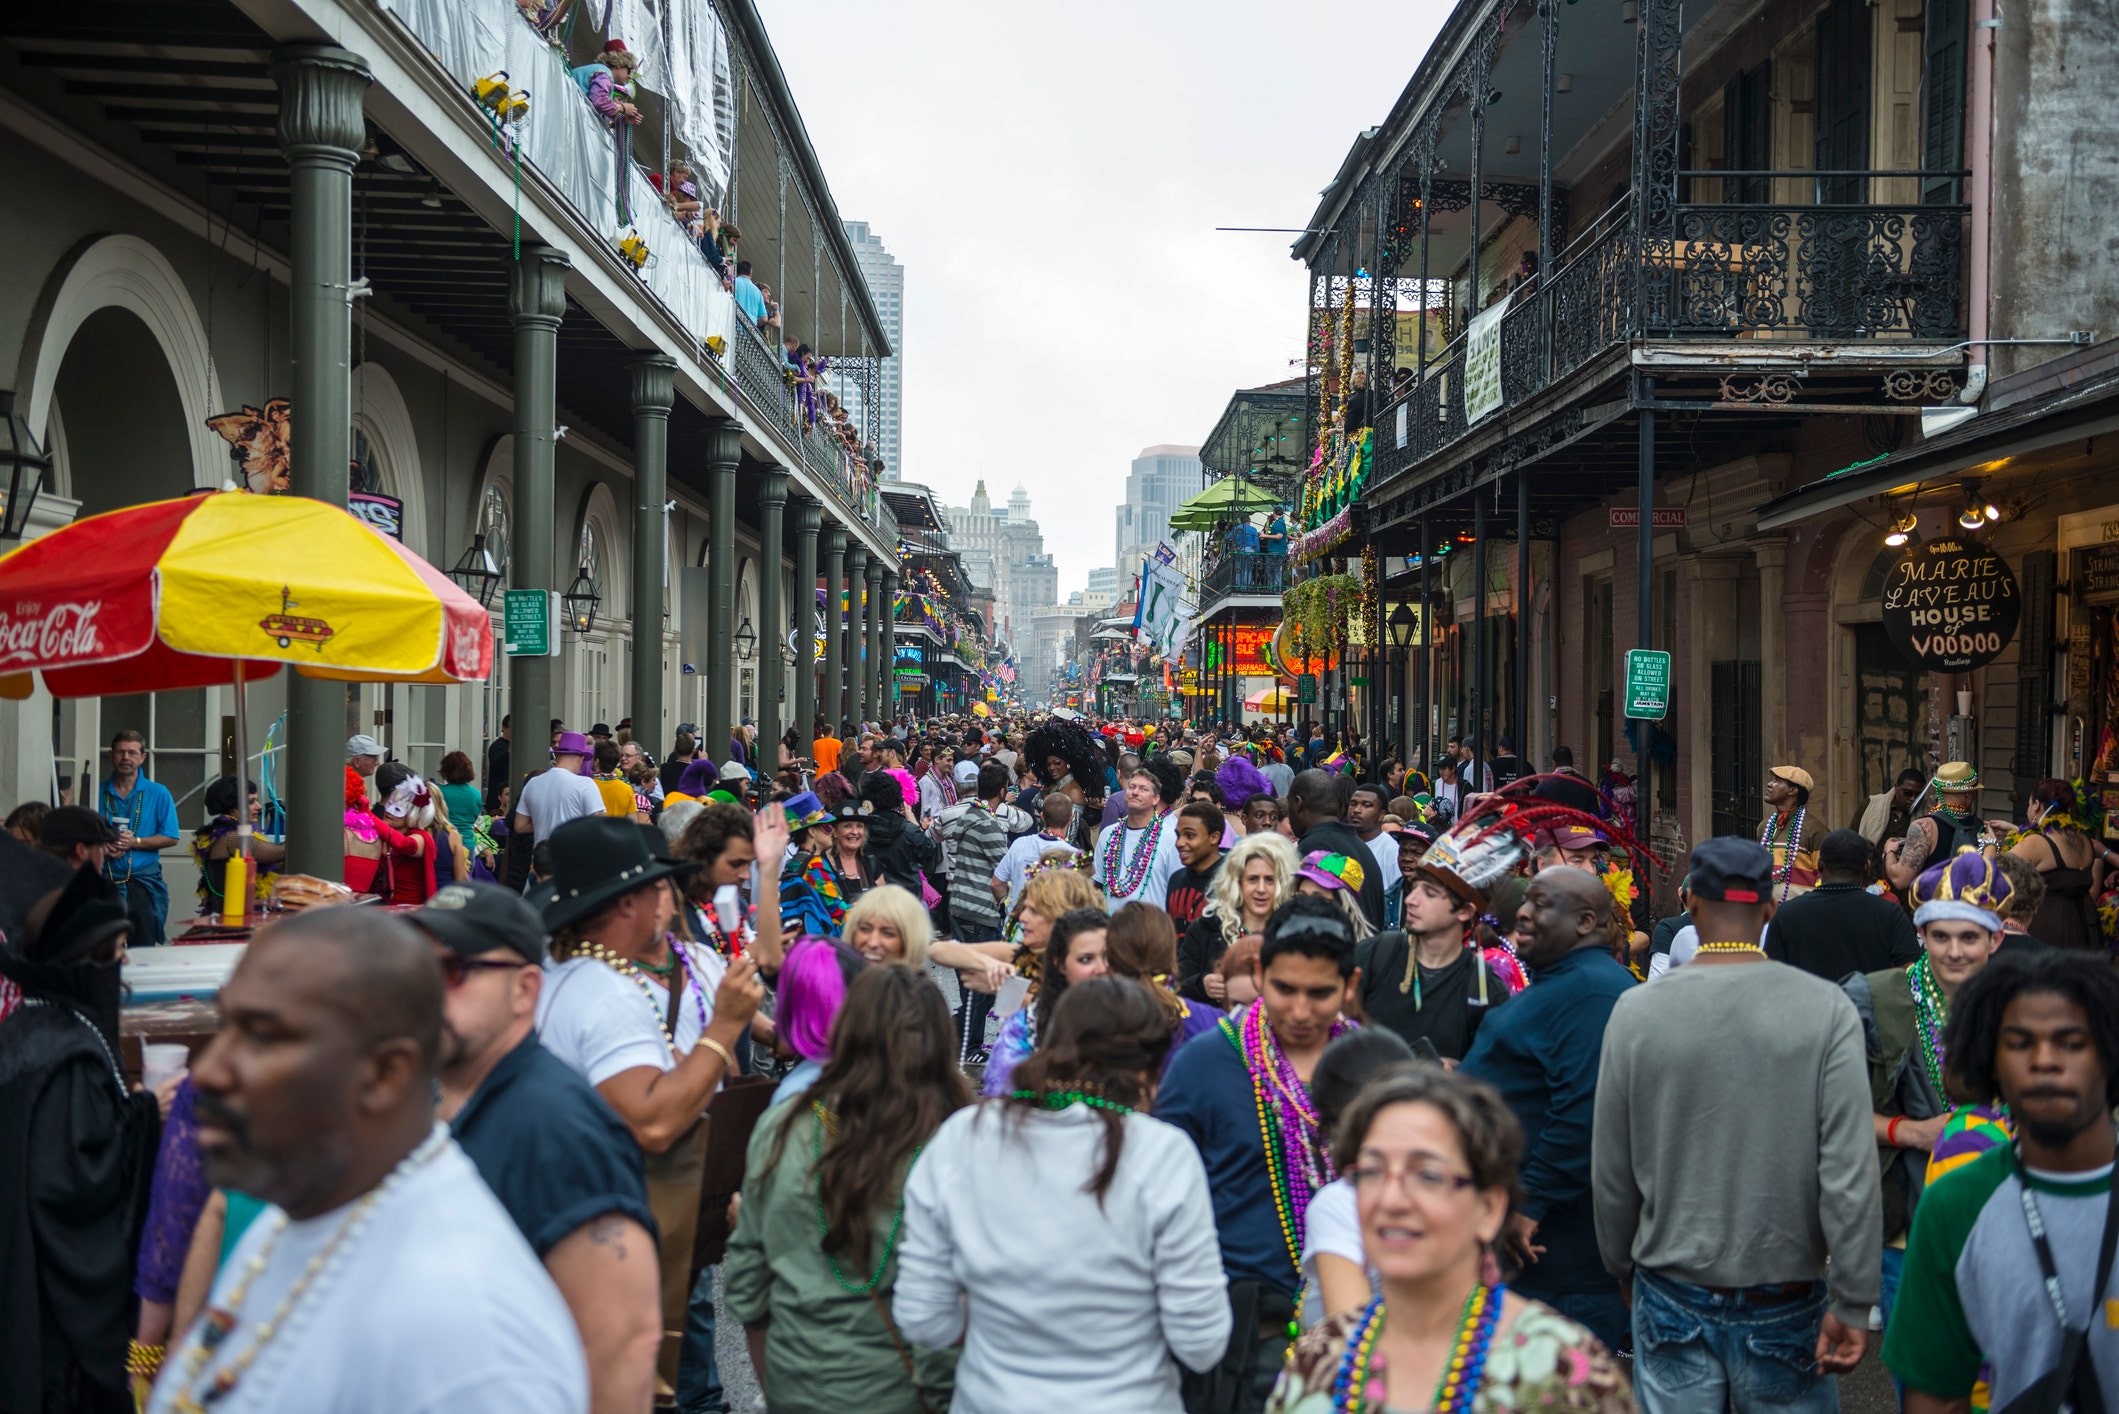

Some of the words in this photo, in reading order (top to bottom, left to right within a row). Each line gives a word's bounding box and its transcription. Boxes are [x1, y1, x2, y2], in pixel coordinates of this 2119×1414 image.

[1612, 512, 1684, 523] COMRCIAL
[1900, 557, 1999, 586] MARIE
[1885, 576, 2012, 610] LAVEAU'S
[1910, 604, 1991, 627] HOUSE
[1944, 620, 1965, 635] of
[1234, 643, 1255, 655] SLE
[1911, 632, 2001, 658] VOODOO
[1643, 656, 1666, 664] BOTTLES
